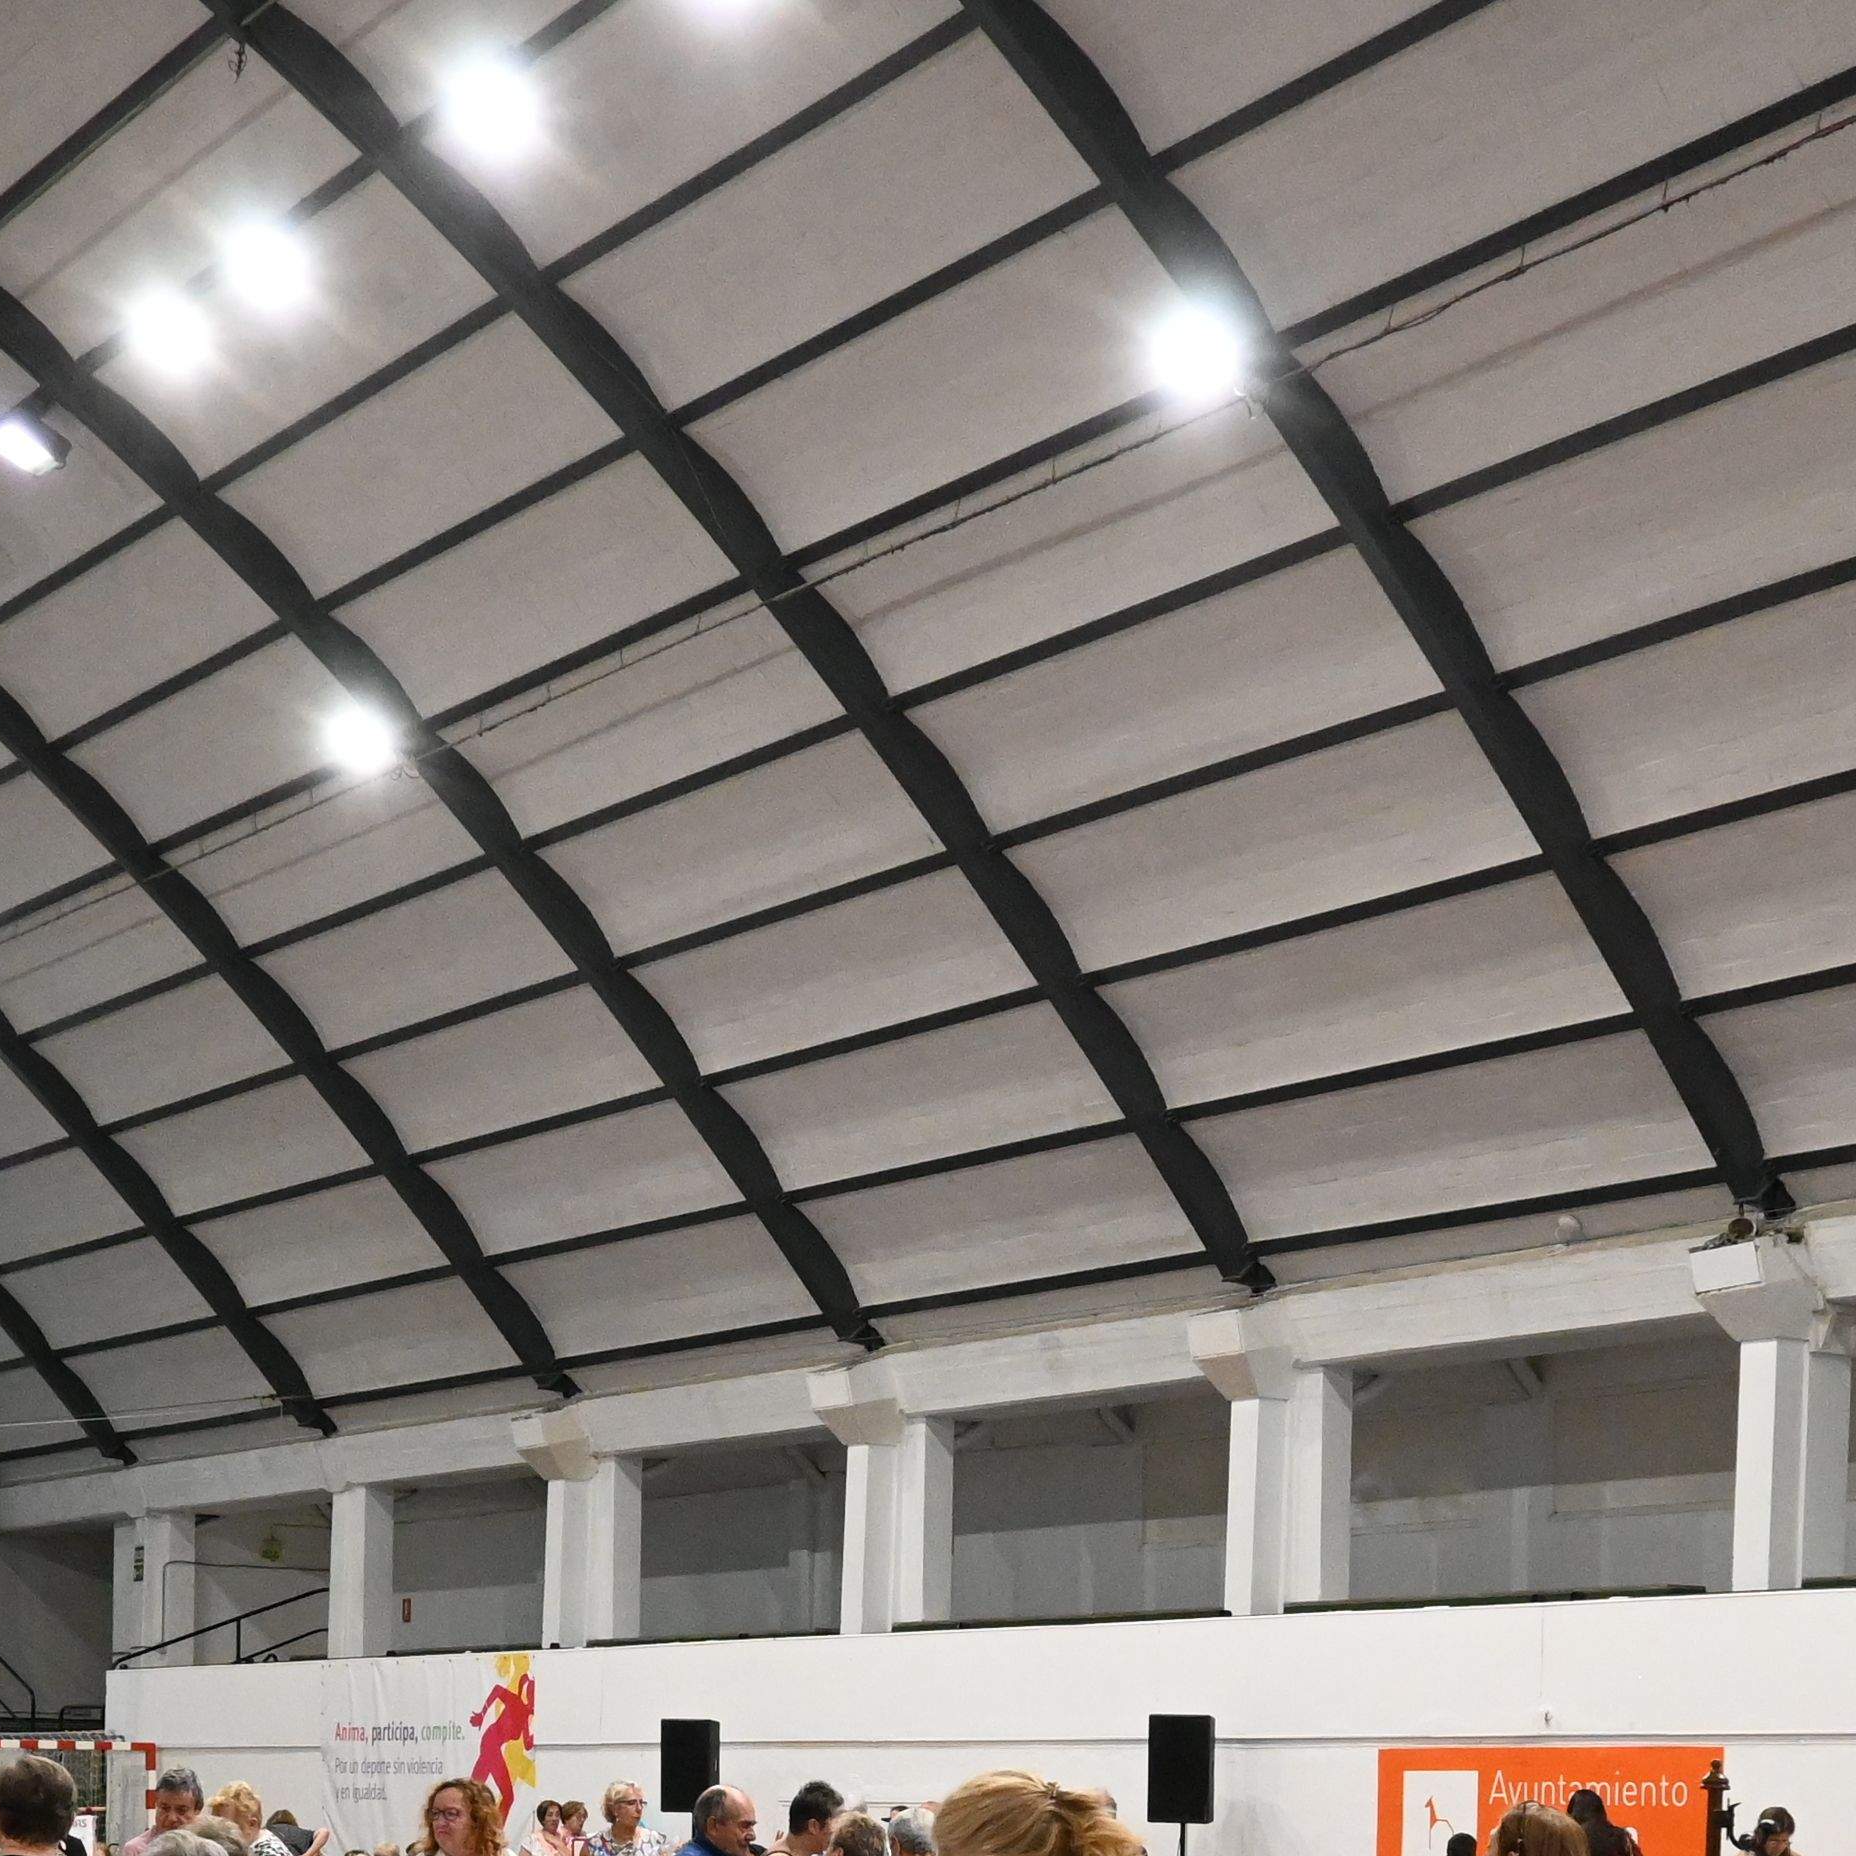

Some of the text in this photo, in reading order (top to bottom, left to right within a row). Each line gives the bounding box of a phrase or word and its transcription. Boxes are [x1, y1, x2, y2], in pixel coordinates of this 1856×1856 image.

[349, 1762, 359, 1775] un
[361, 1757, 391, 1778] deporte
[393, 1757, 407, 1775] sin
[407, 1757, 444, 1775] violencia
